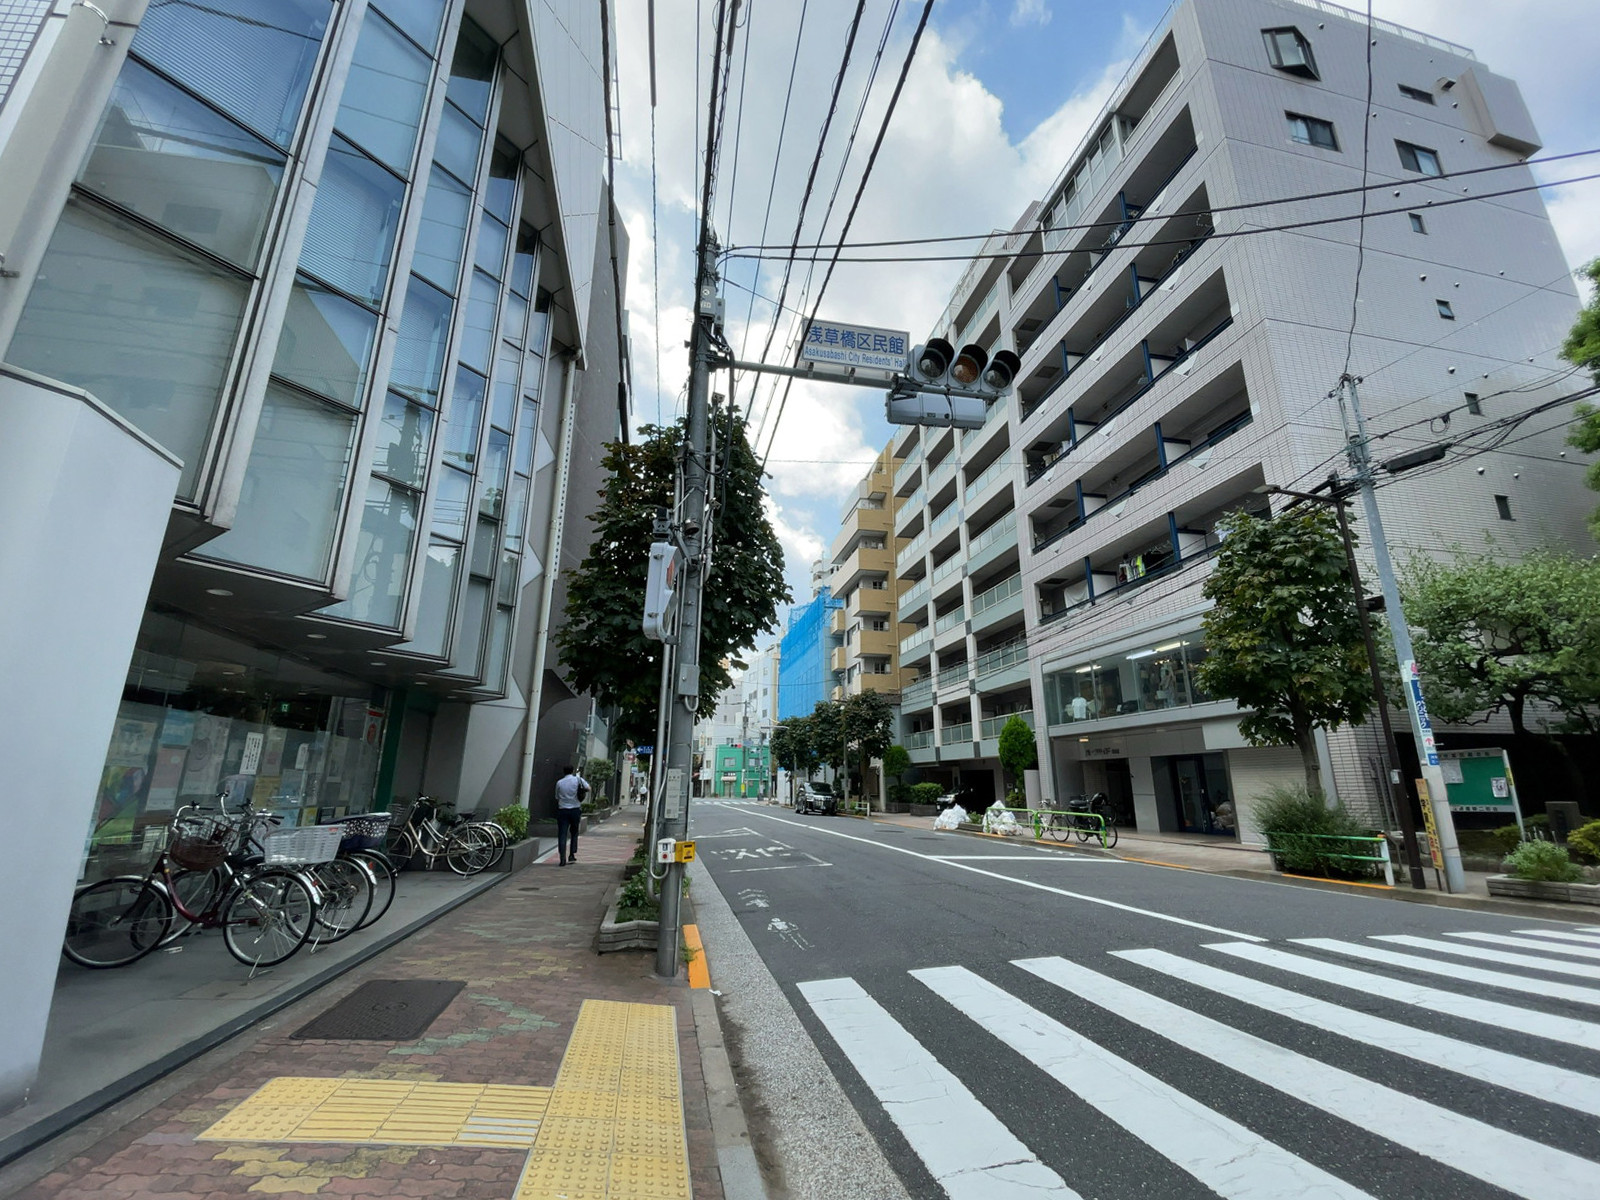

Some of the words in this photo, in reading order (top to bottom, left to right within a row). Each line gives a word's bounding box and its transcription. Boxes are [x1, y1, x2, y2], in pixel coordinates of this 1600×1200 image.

[807, 326, 904, 355] 浅草橋区民館
[805, 346, 847, 361] Asakusabashi
[849, 351, 860, 364] City
